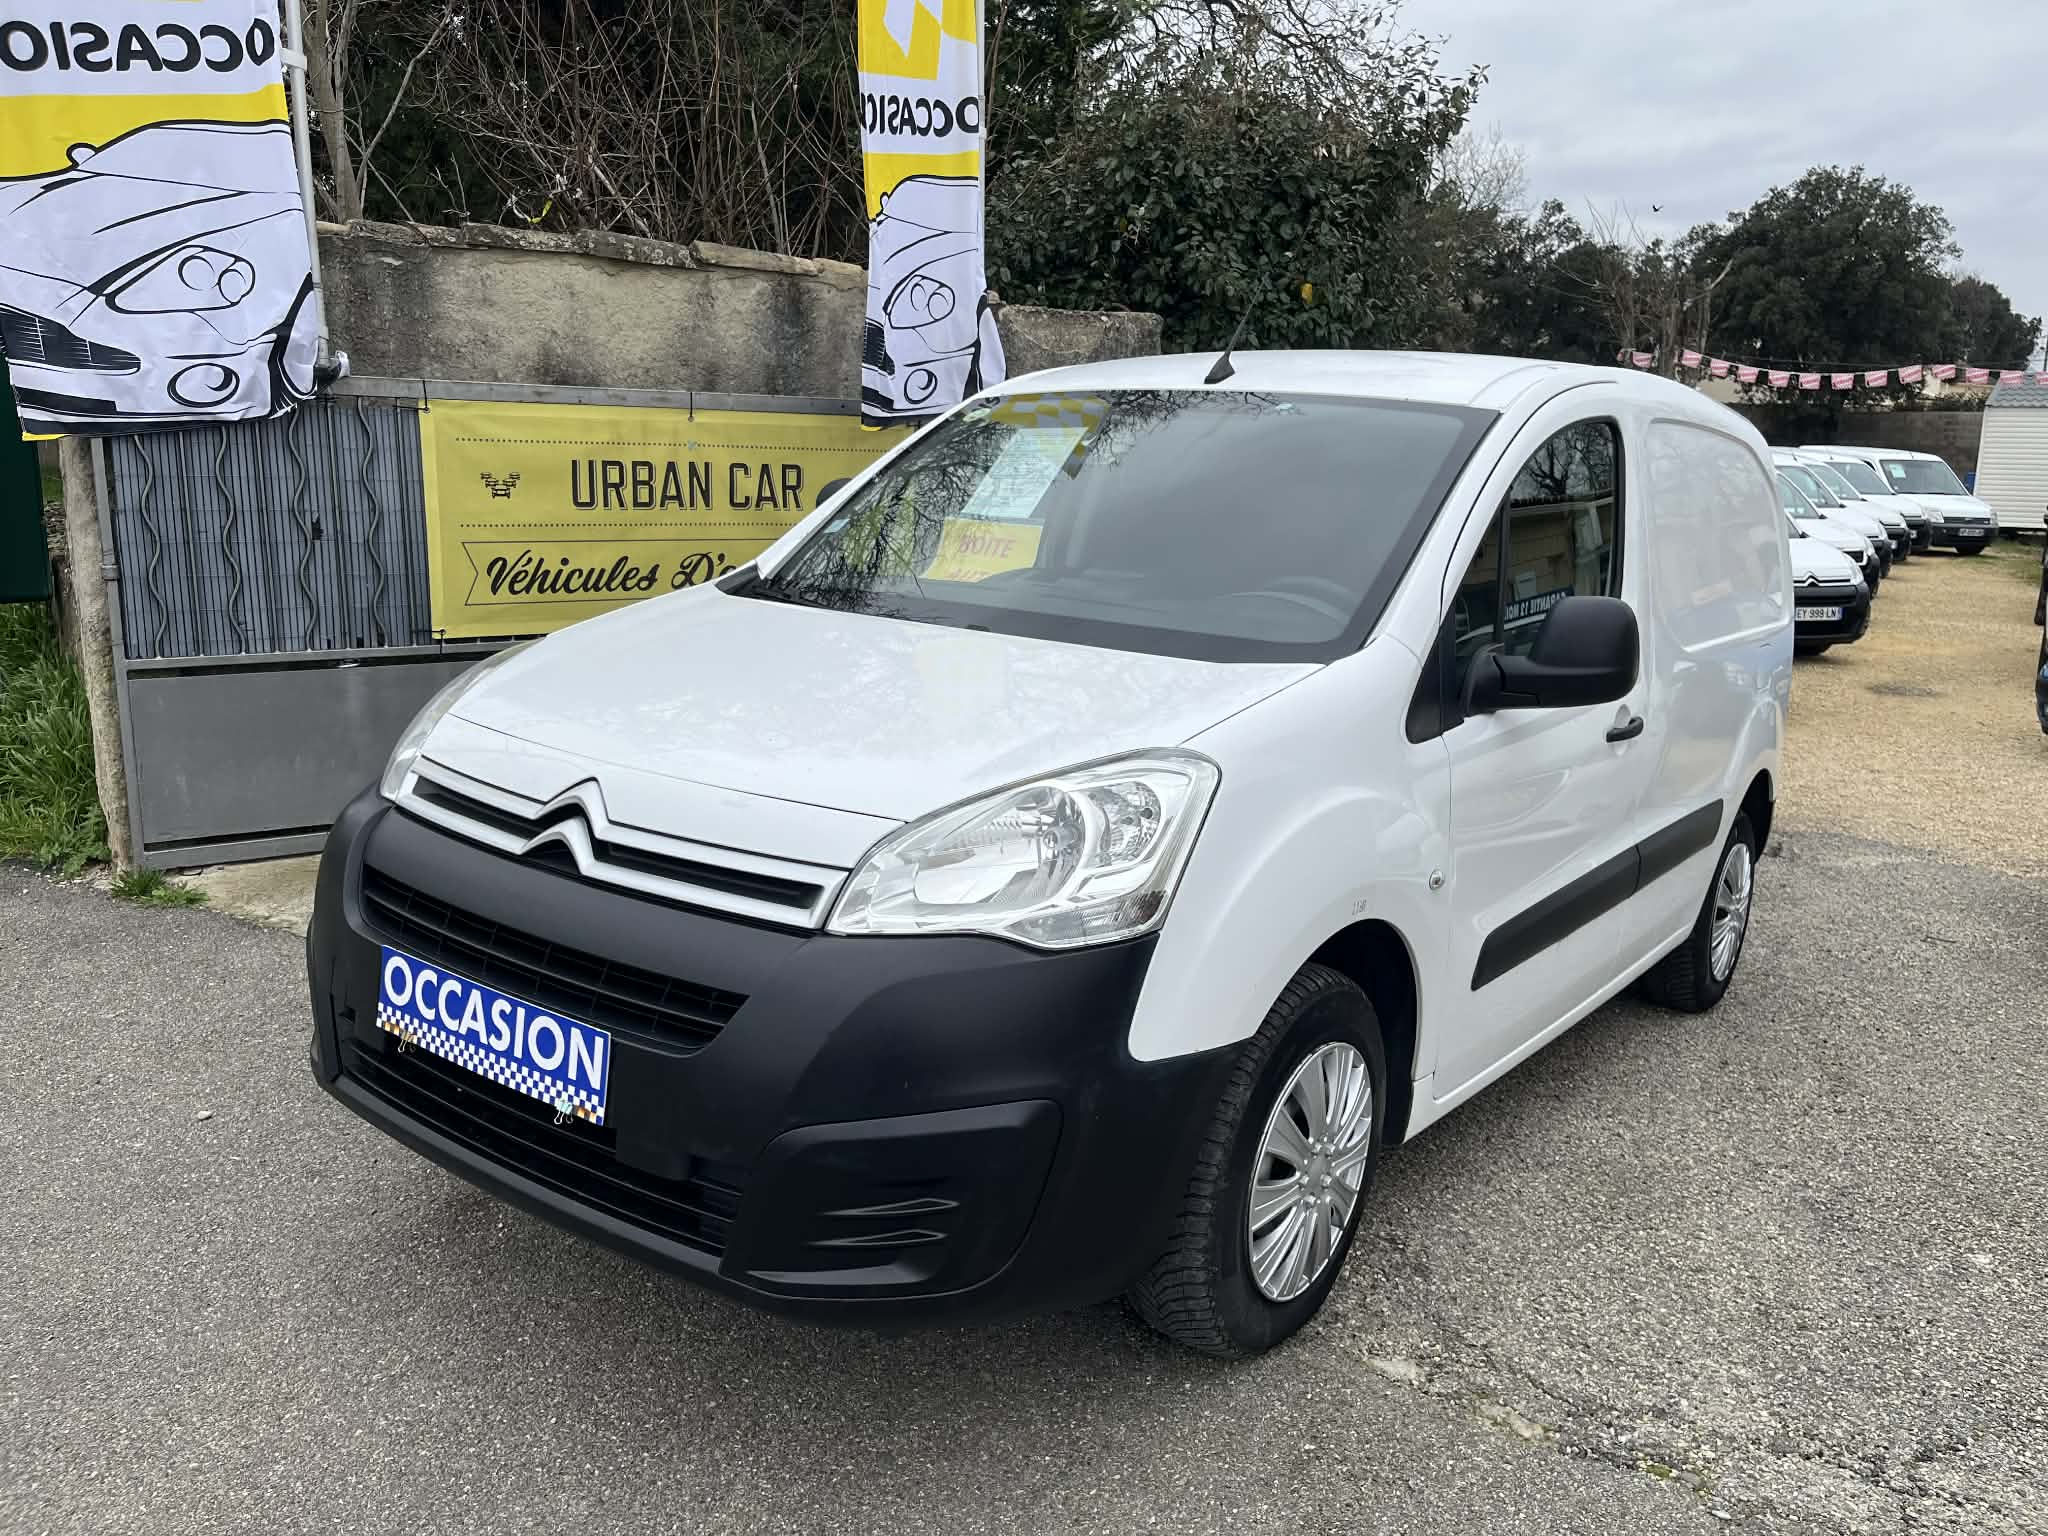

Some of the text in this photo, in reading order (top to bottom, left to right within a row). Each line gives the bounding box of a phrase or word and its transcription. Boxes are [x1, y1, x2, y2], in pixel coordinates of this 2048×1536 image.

[571, 459, 804, 512] URBAN CAR
[486, 549, 660, 596] Véhicules
[384, 955, 604, 1090] OCCASION
